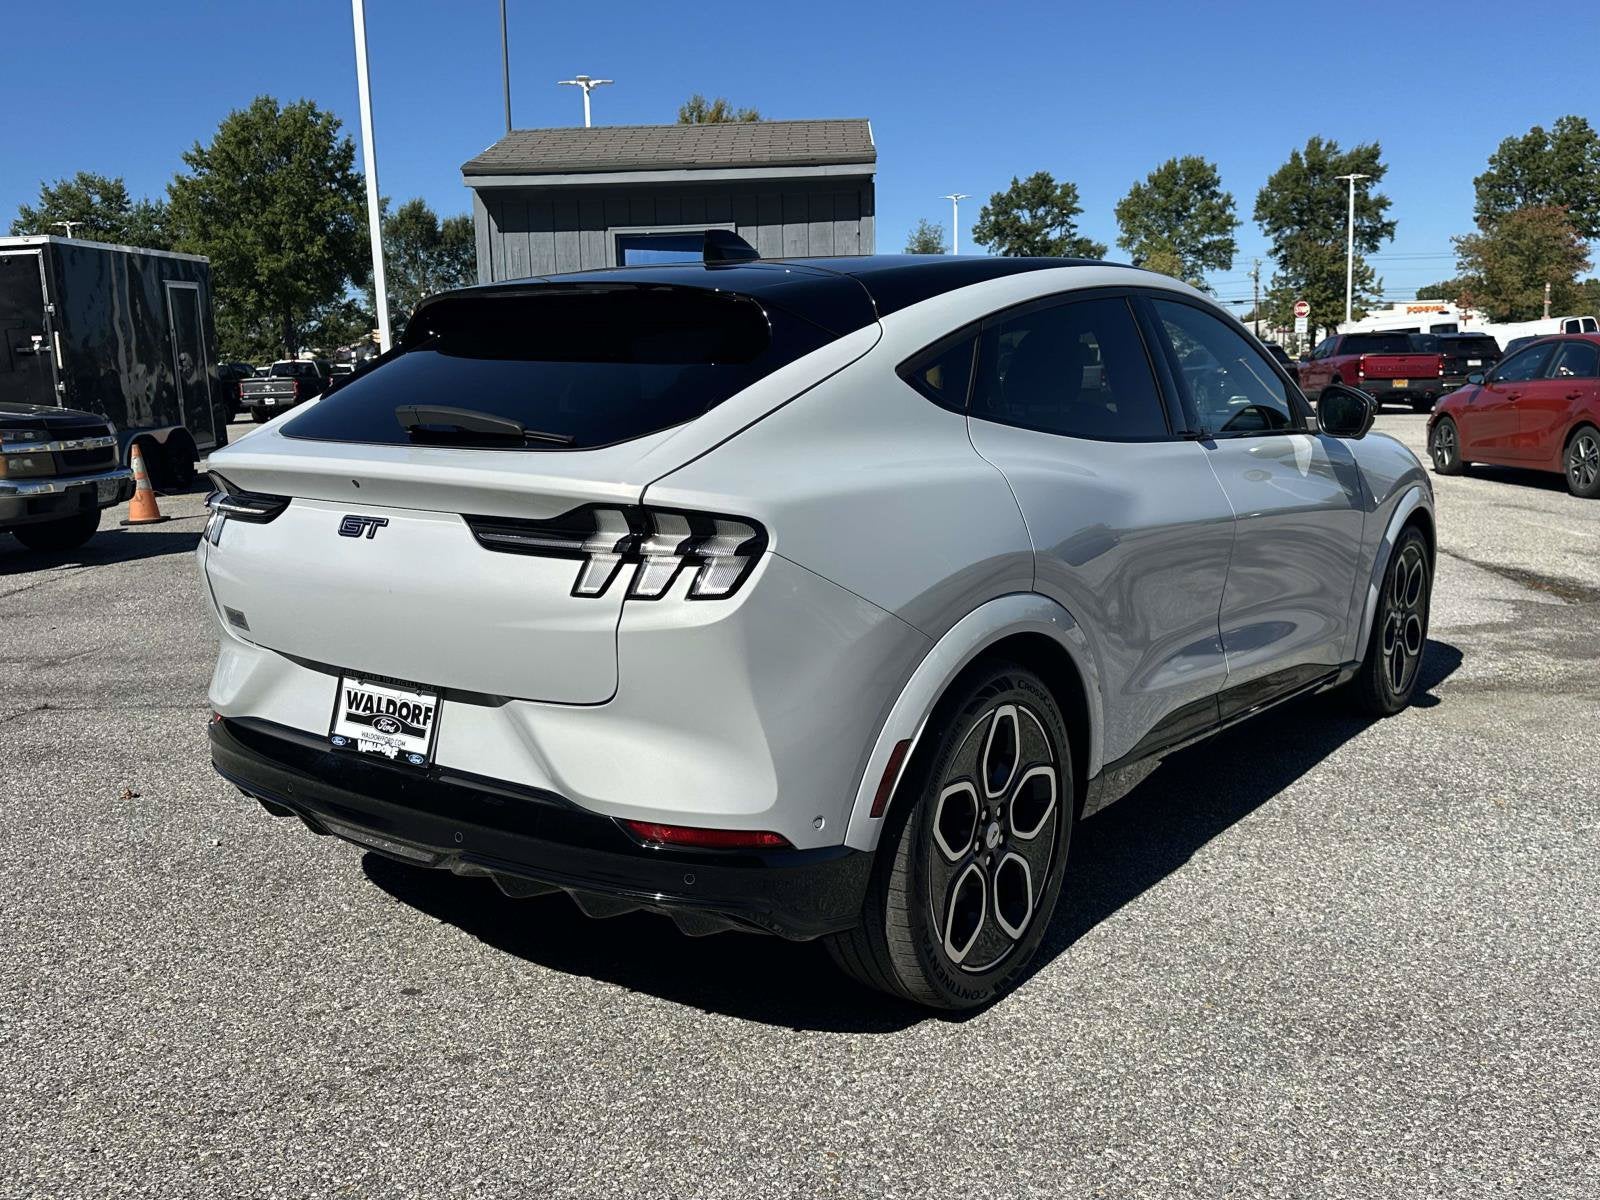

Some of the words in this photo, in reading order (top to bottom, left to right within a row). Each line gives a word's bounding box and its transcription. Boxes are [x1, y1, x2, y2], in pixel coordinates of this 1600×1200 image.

[1295, 305, 1310, 314] STOP
[338, 514, 389, 539] GT
[346, 690, 433, 726] WALDORF
[378, 718, 397, 733] Ford
